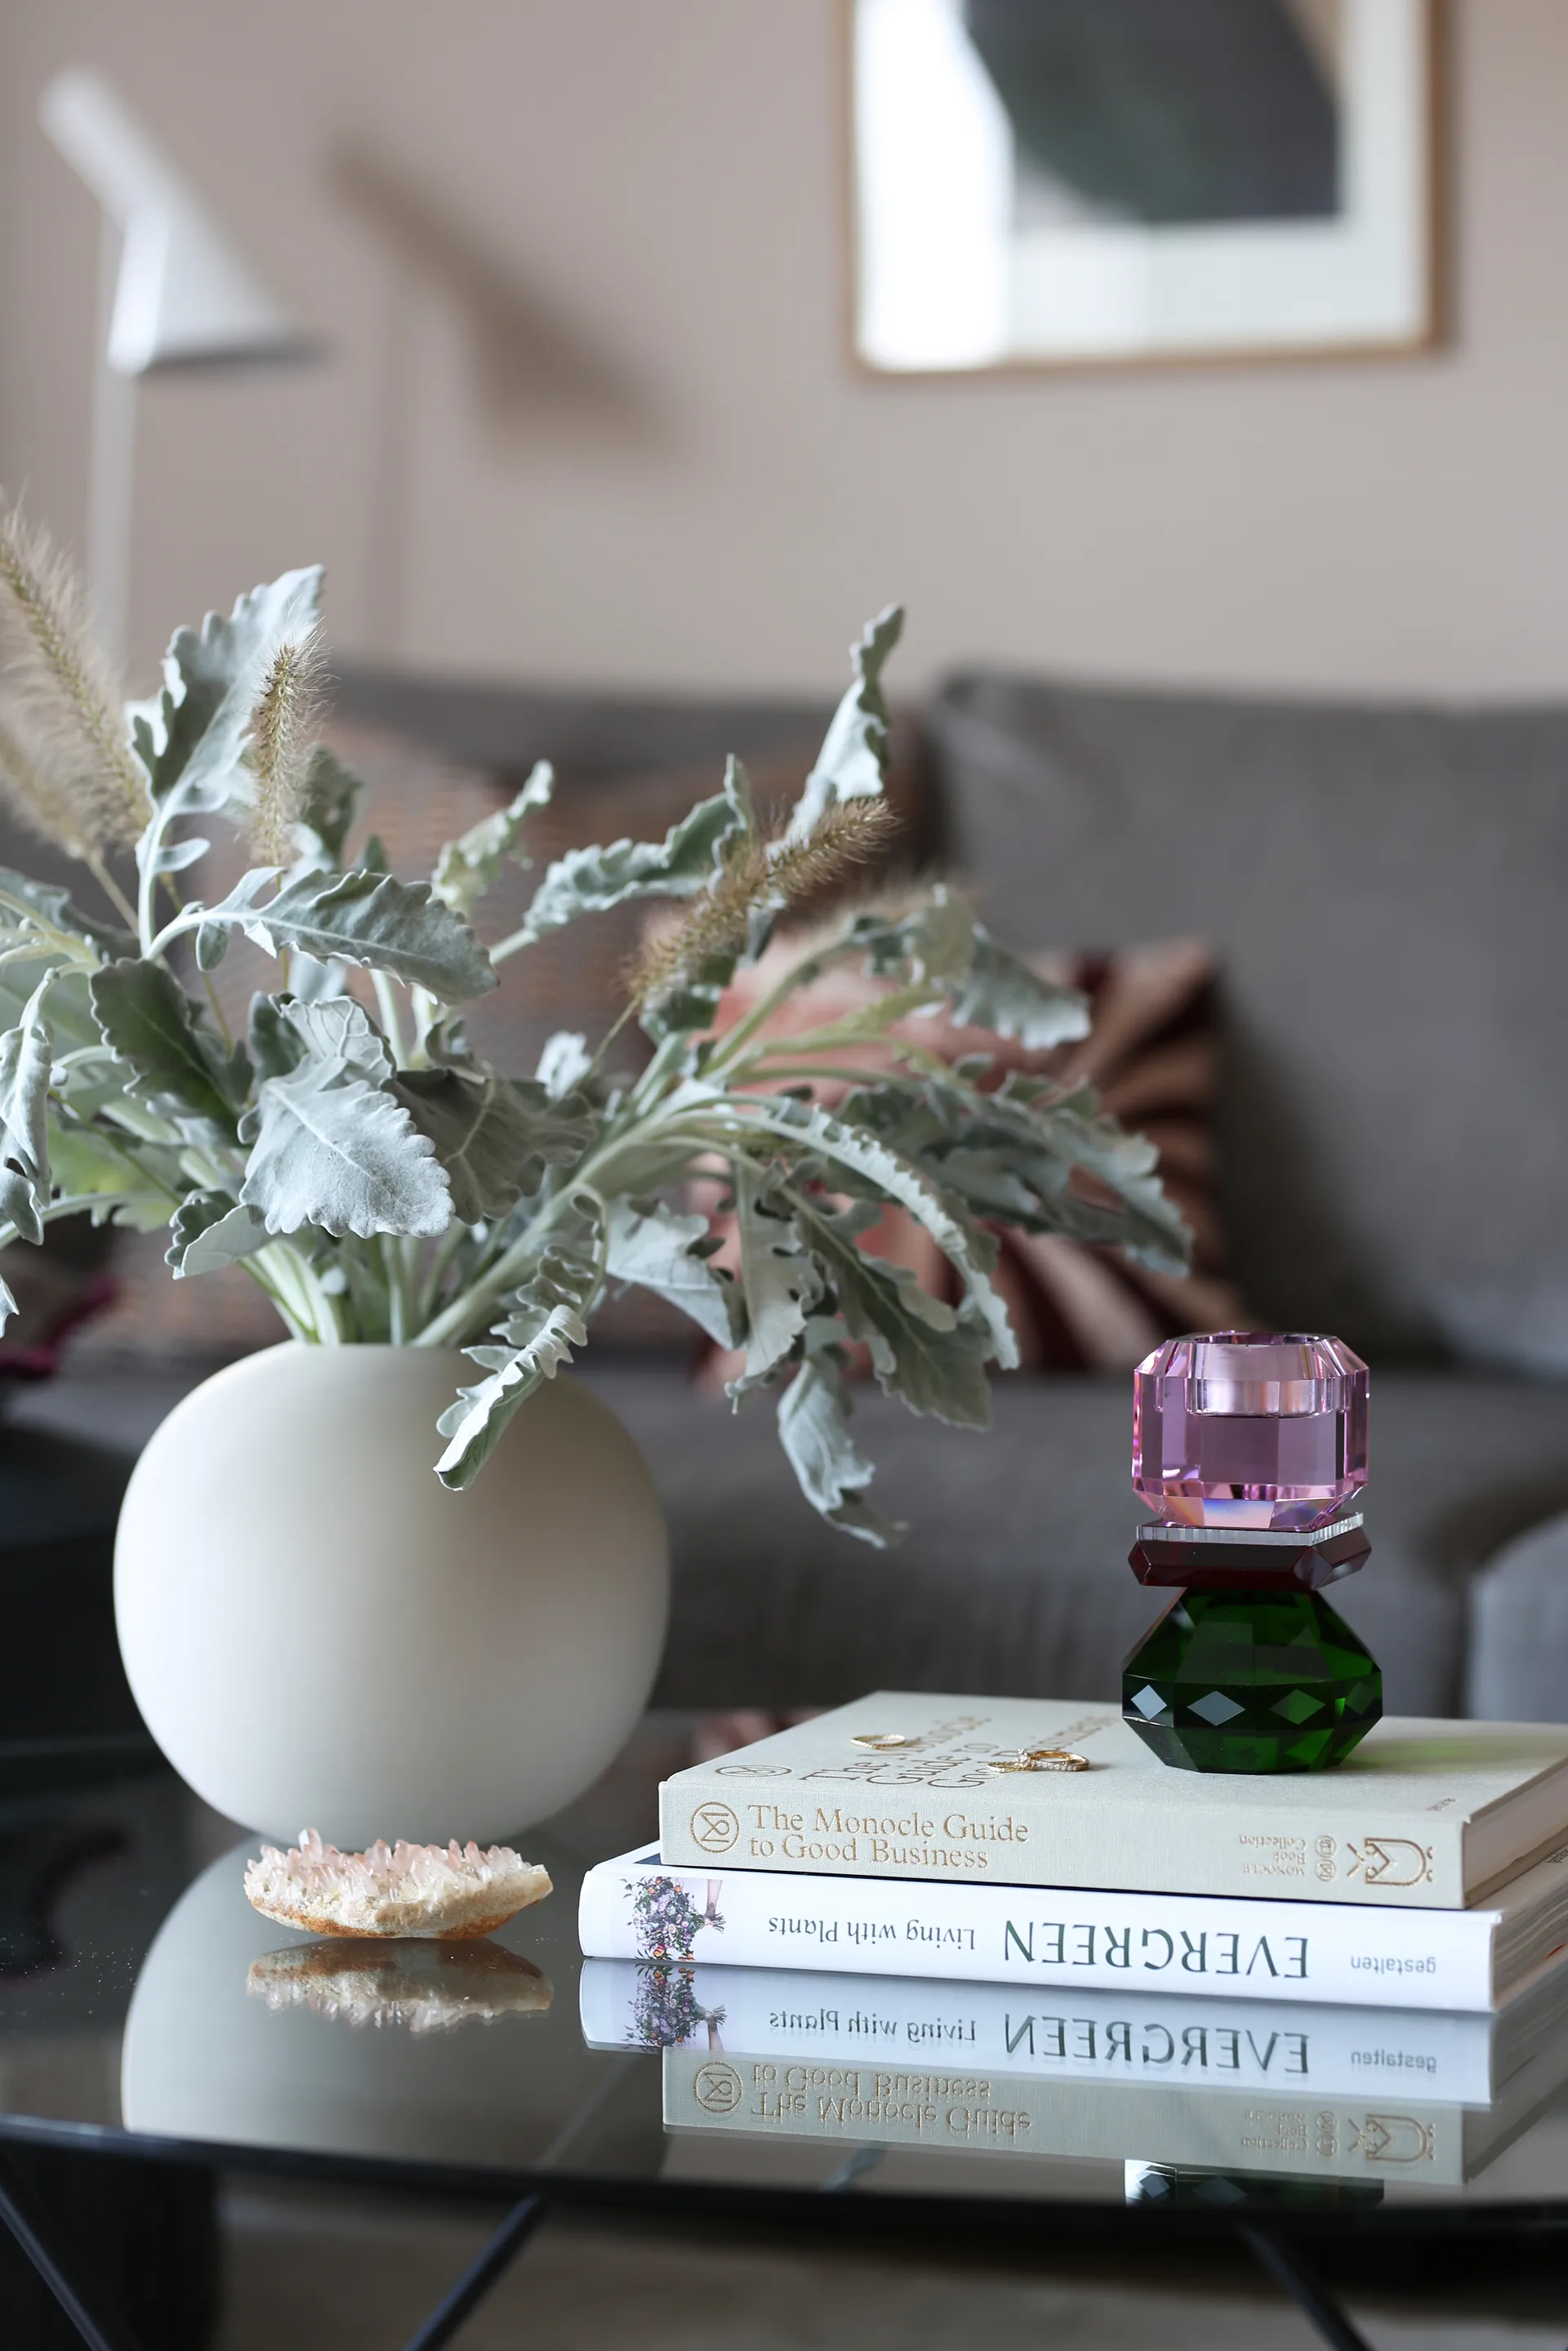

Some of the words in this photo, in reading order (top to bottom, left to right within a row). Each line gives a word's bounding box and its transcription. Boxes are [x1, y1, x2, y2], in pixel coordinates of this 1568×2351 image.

[800, 1761, 890, 1781] The
[866, 1756, 972, 1785] Guide
[747, 1804, 804, 1831] The
[814, 1807, 935, 1837] Monocle
[943, 1813, 1030, 1842] Guide
[751, 1836, 775, 1858] to
[782, 1834, 858, 1862] Good
[869, 1837, 989, 1869] Business
[768, 1917, 839, 1944] Plants
[847, 1921, 897, 1945] with
[906, 1919, 975, 1951] Living
[1004, 1920, 1309, 1979] EVERGREEN
[1351, 1956, 1437, 1975] gestalten
